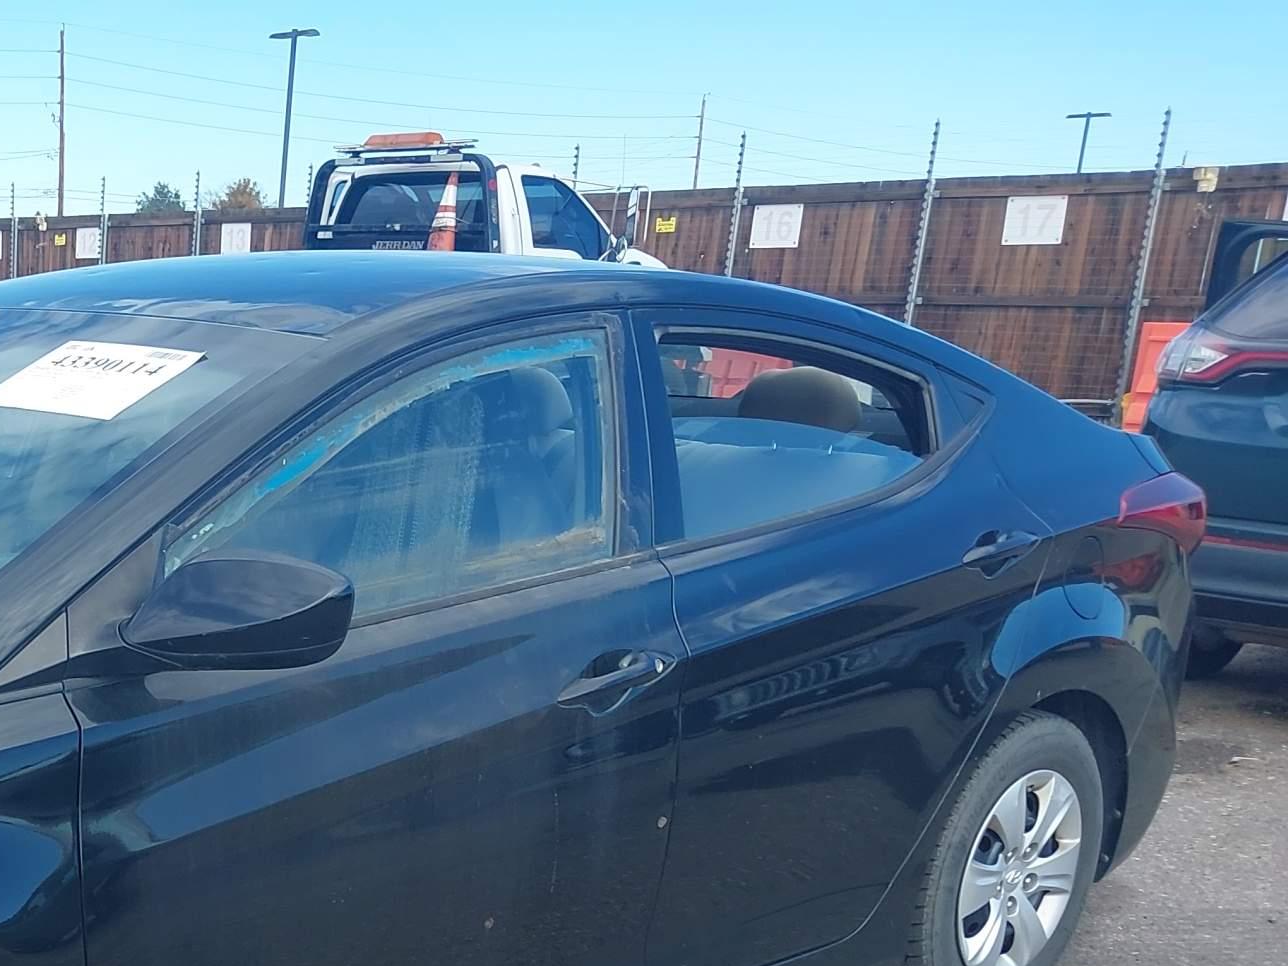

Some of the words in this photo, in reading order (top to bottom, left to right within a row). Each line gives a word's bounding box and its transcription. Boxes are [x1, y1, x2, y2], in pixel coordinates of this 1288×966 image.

[762, 210, 794, 241] 16
[1017, 203, 1057, 238] 17
[52, 354, 168, 377] 43390114
